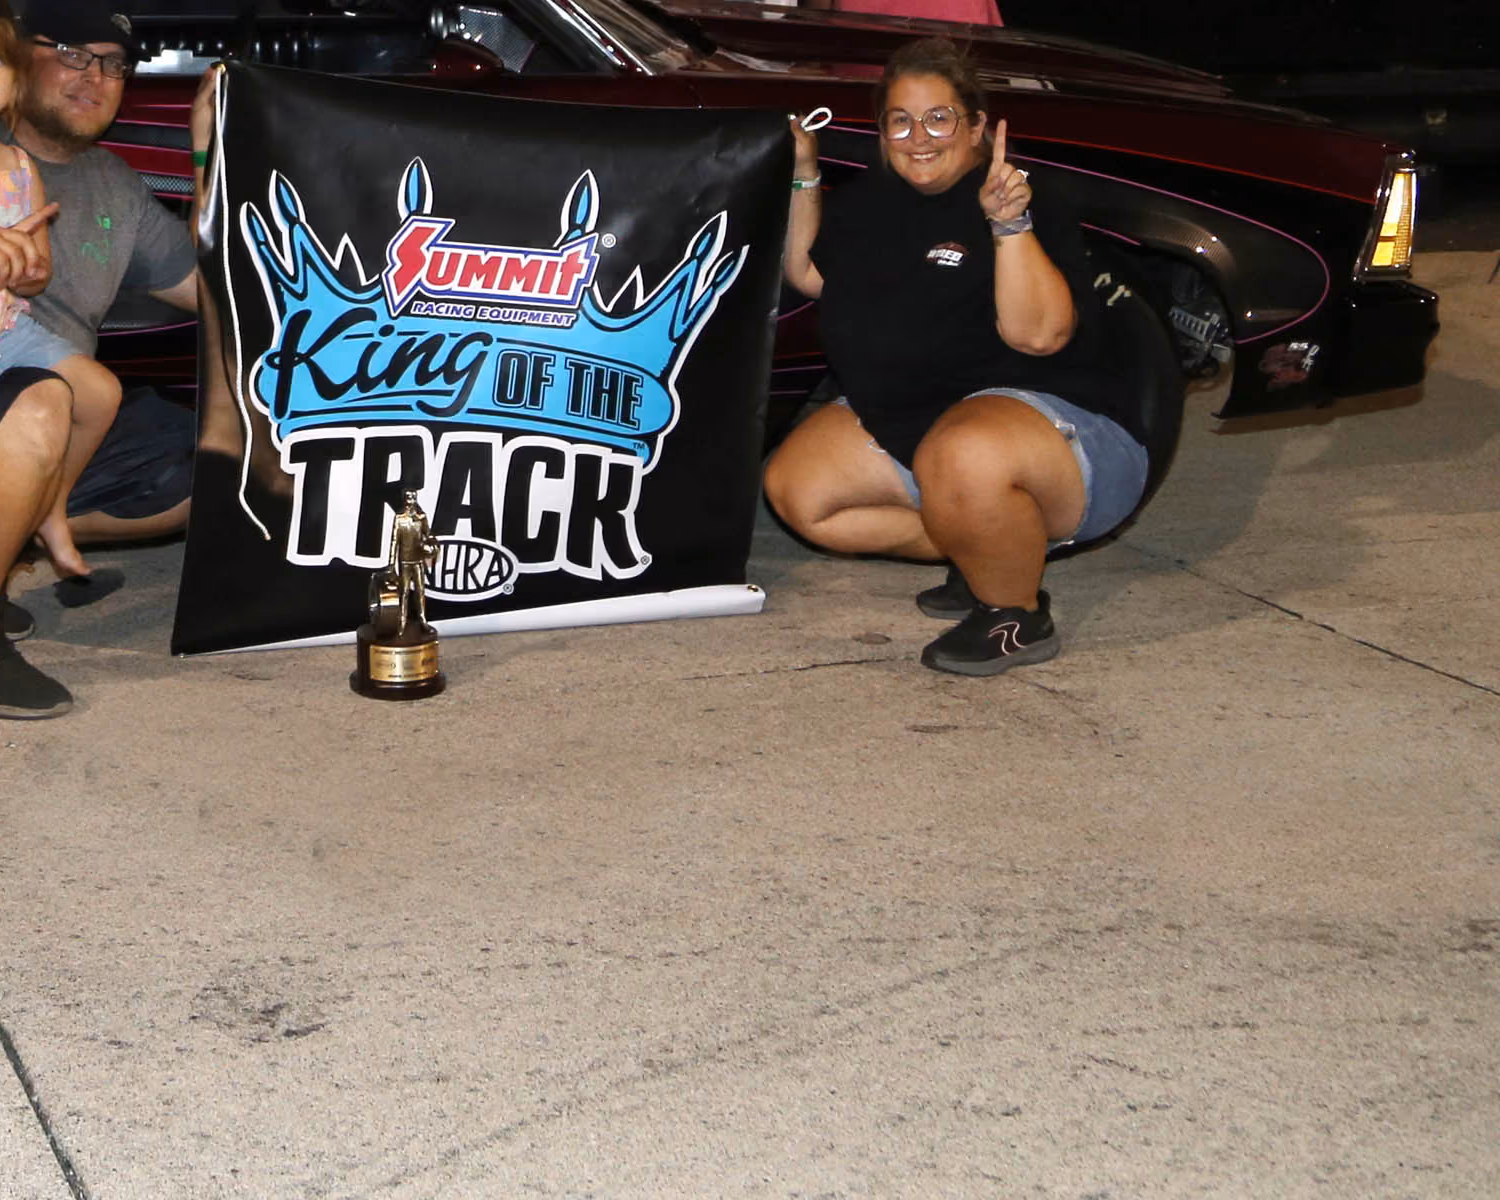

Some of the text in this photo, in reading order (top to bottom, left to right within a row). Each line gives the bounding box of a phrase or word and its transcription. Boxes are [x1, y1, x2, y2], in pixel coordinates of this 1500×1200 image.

[266, 306, 645, 431] King OF THE
[411, 302, 577, 328] RACING EQUIPMENT
[287, 432, 648, 573] TRACK
